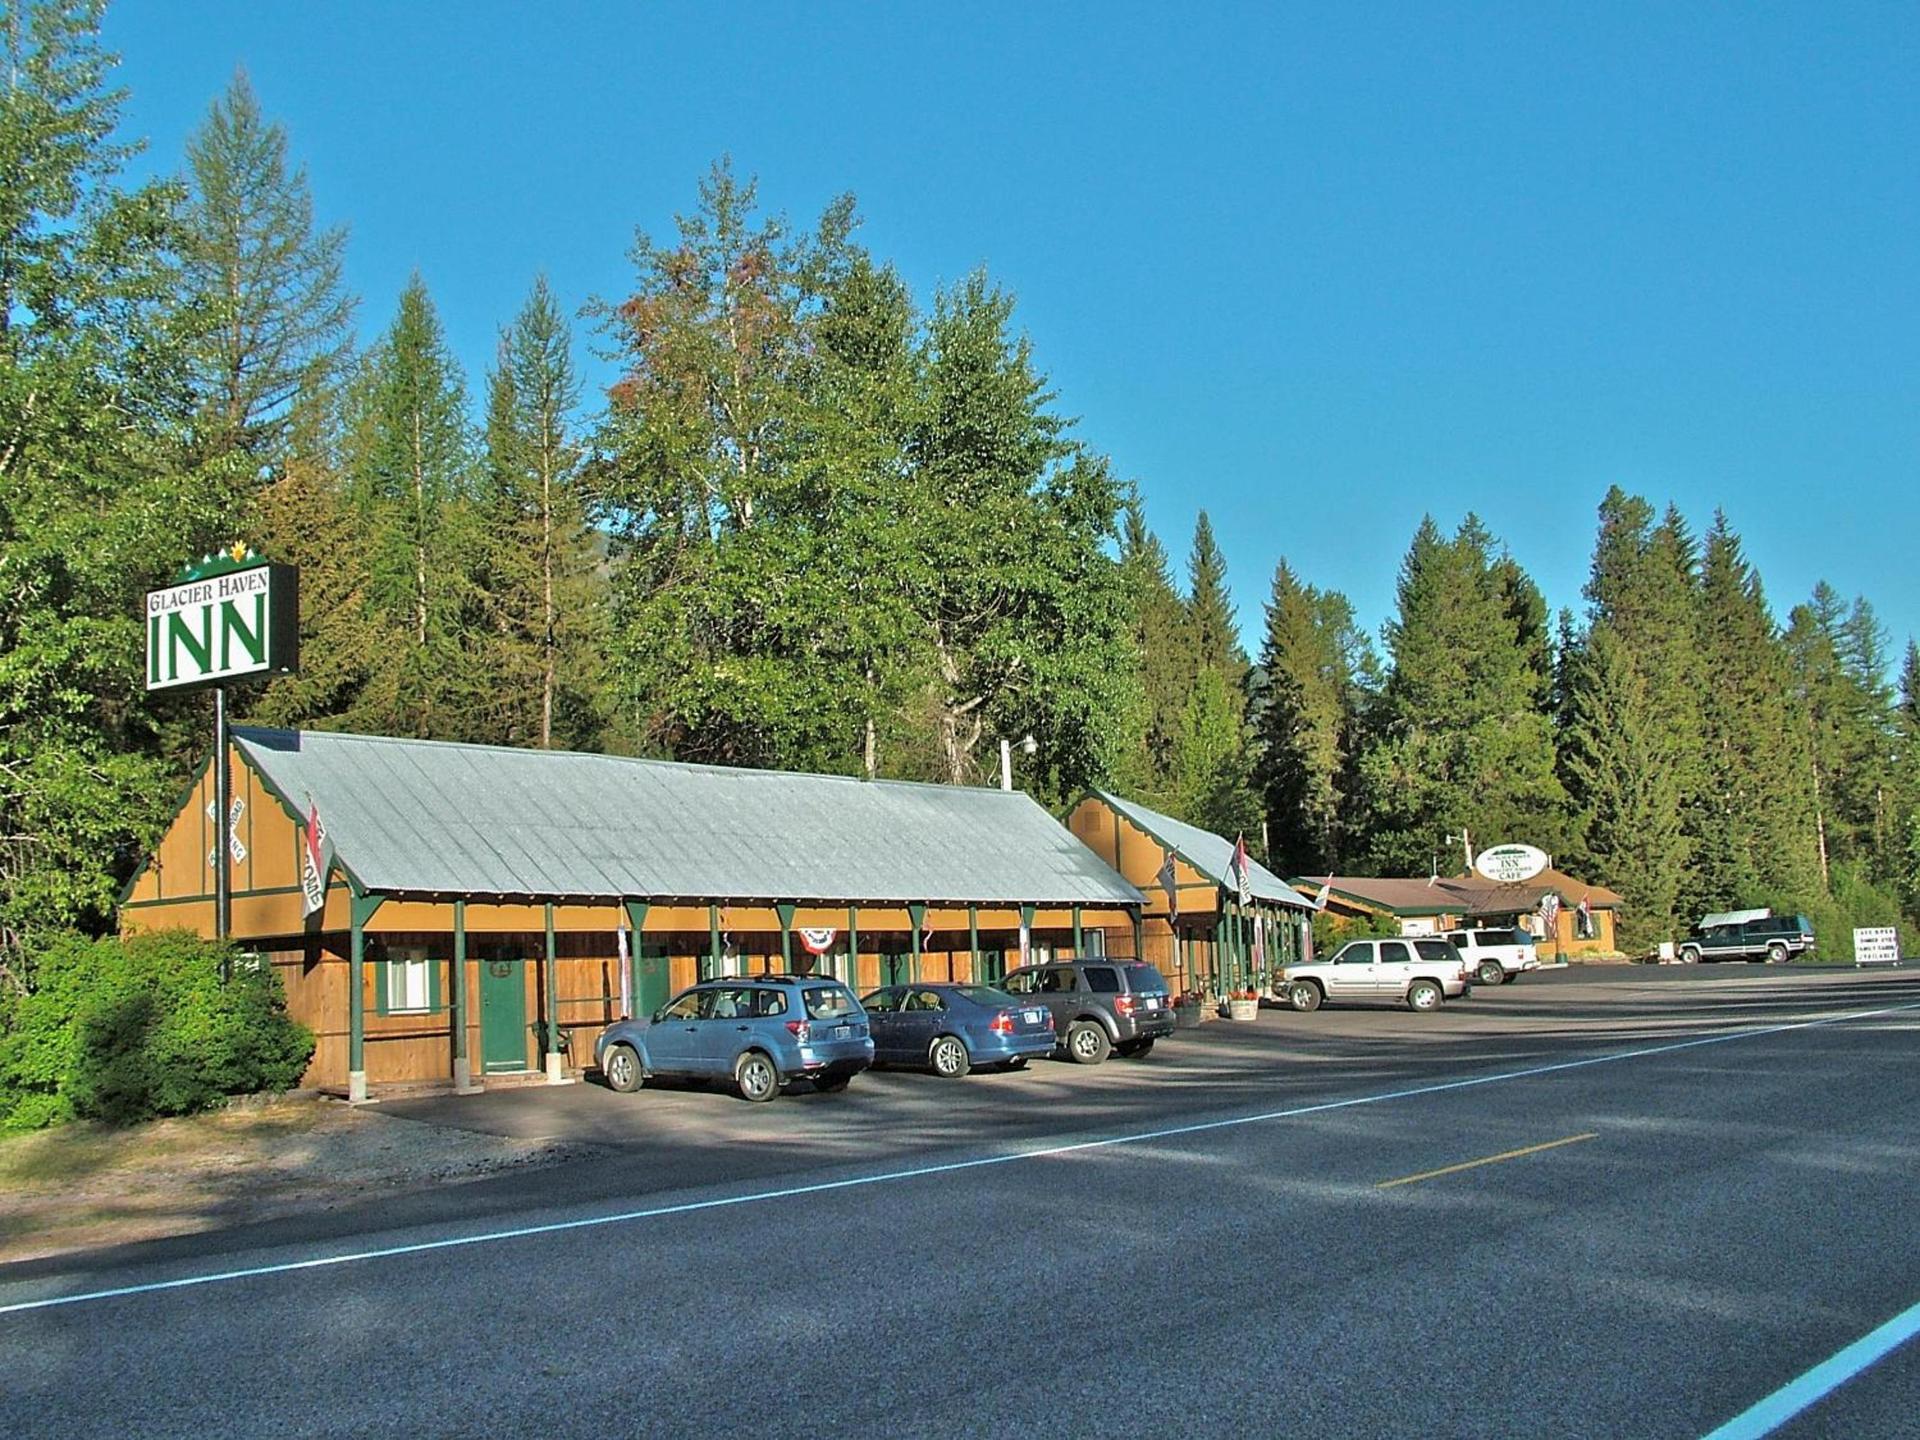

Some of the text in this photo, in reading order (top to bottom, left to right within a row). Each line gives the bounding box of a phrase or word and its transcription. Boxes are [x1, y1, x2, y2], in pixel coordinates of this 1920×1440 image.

[150, 572, 267, 612] GLACIER HAVEN
[150, 592, 266, 684] INN
